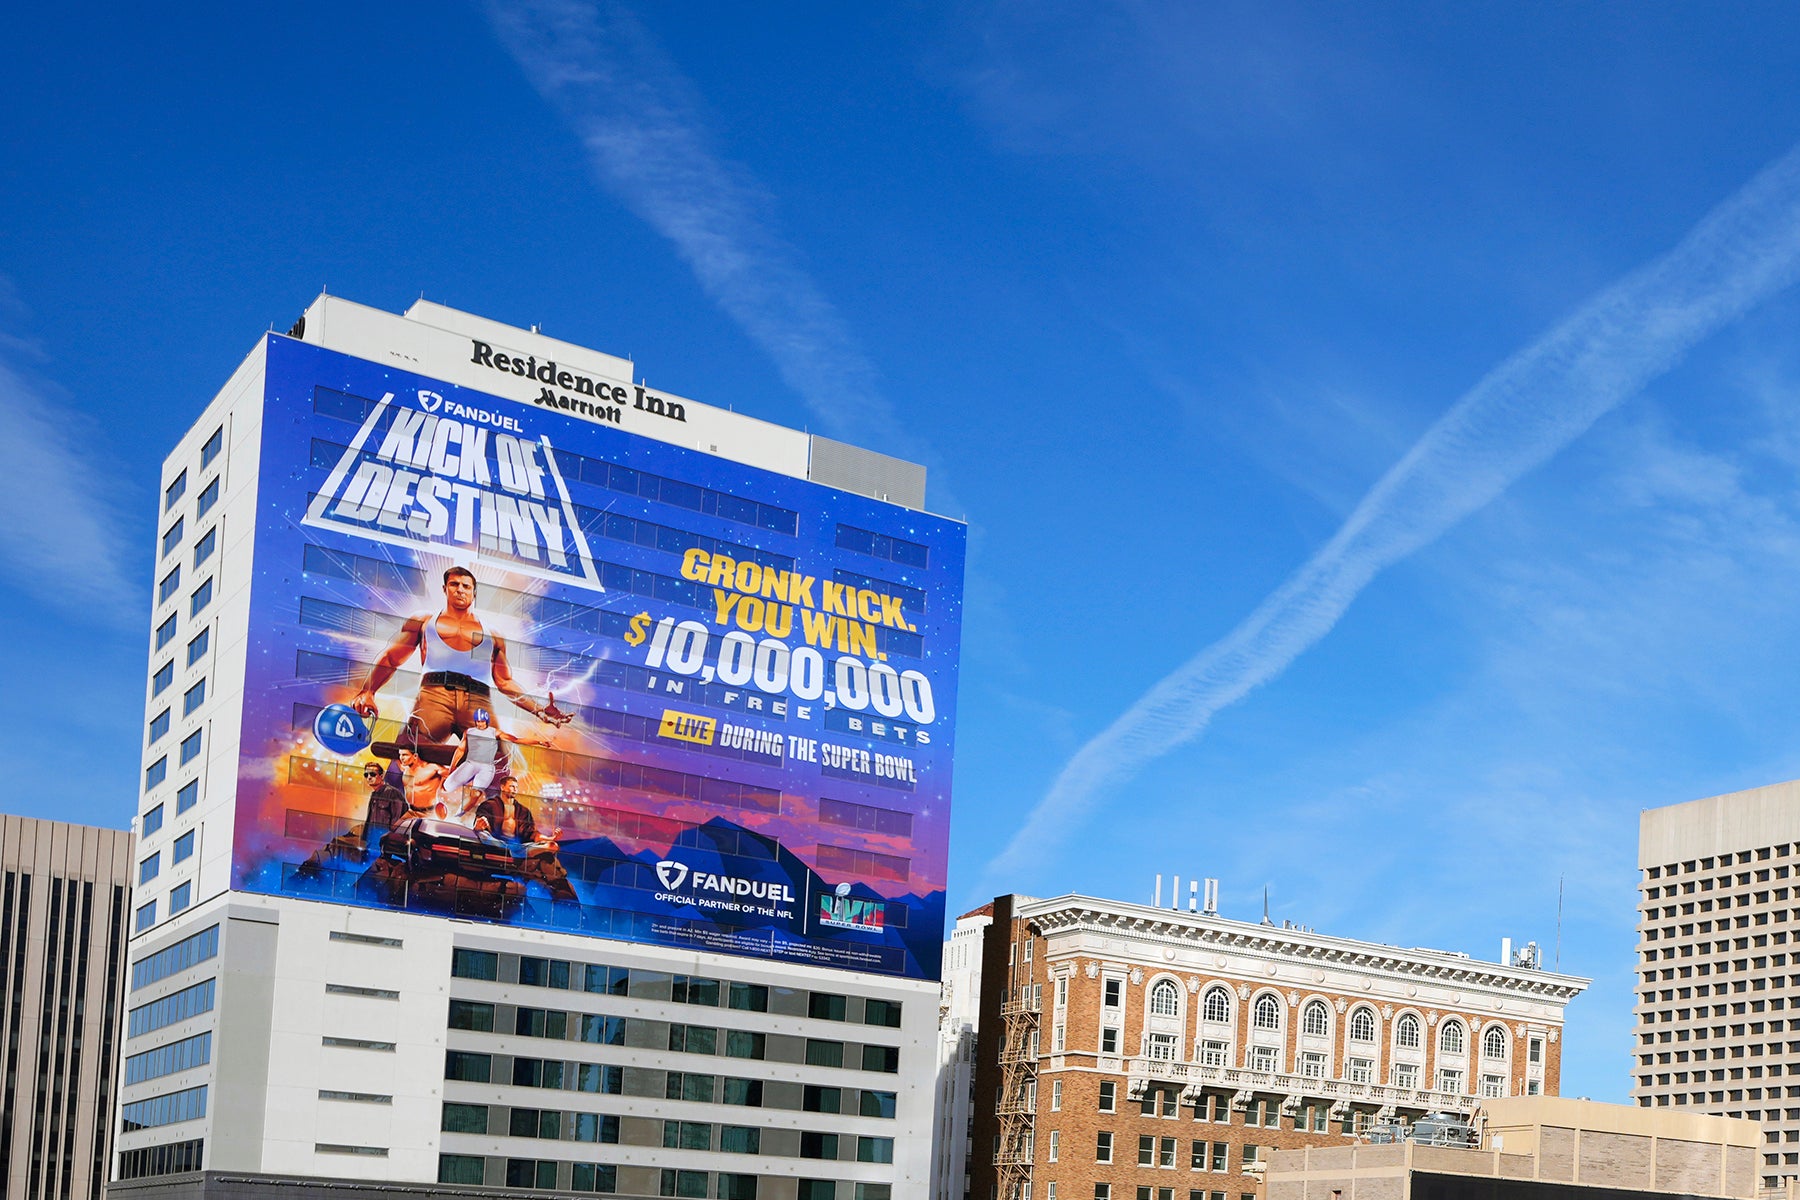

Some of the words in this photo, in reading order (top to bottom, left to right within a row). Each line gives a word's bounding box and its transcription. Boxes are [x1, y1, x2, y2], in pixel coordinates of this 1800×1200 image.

[471, 339, 628, 405] Residence
[633, 386, 687, 422] Inn
[534, 387, 622, 424] Marriott
[376, 406, 491, 485] KICK
[496, 434, 546, 499] OF
[444, 401, 523, 433] FANDUEL
[334, 460, 568, 567] DESTINY
[681, 548, 816, 608] GRONK
[823, 579, 917, 632] KICK.
[713, 588, 793, 638] YOU
[801, 608, 888, 662] WIN.
[624, 611, 936, 724] $10,000,000
[648, 676, 684, 694] IN
[723, 691, 811, 719] FREE
[848, 717, 931, 744] BETS
[673, 716, 711, 741] LIVE
[720, 723, 784, 758] DURING
[788, 735, 817, 763] THE
[822, 742, 871, 775] SUPER
[875, 752, 918, 783] BOWL
[654, 892, 697, 906] OFFICIAL
[698, 898, 740, 912] PARTNER
[742, 904, 755, 914] OF
[757, 907, 774, 917] THE
[777, 909, 794, 920] NFL
[692, 872, 795, 903] FANDUEL
